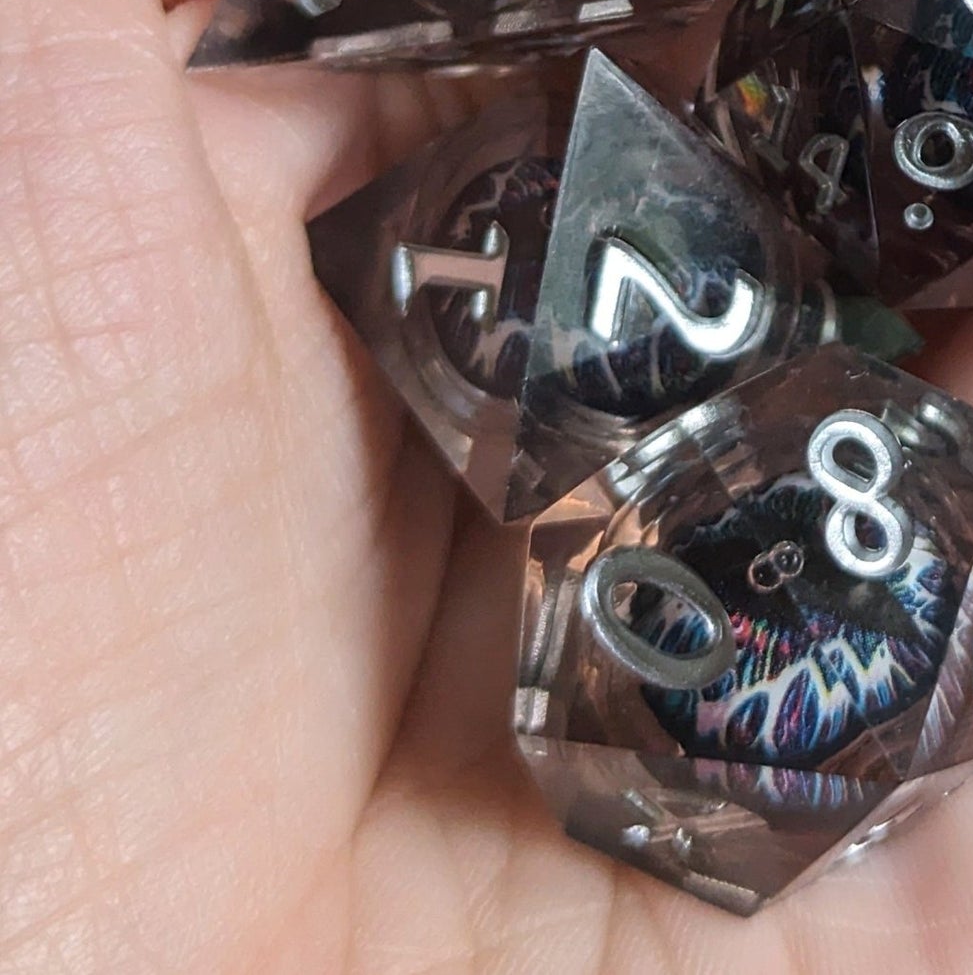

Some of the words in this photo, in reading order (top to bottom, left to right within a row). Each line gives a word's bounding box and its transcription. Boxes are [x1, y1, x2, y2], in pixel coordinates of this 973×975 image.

[390, 220, 509, 322] 1
[590, 233, 769, 362] 2
[807, 408, 913, 579] 8
[580, 545, 737, 691] 0
